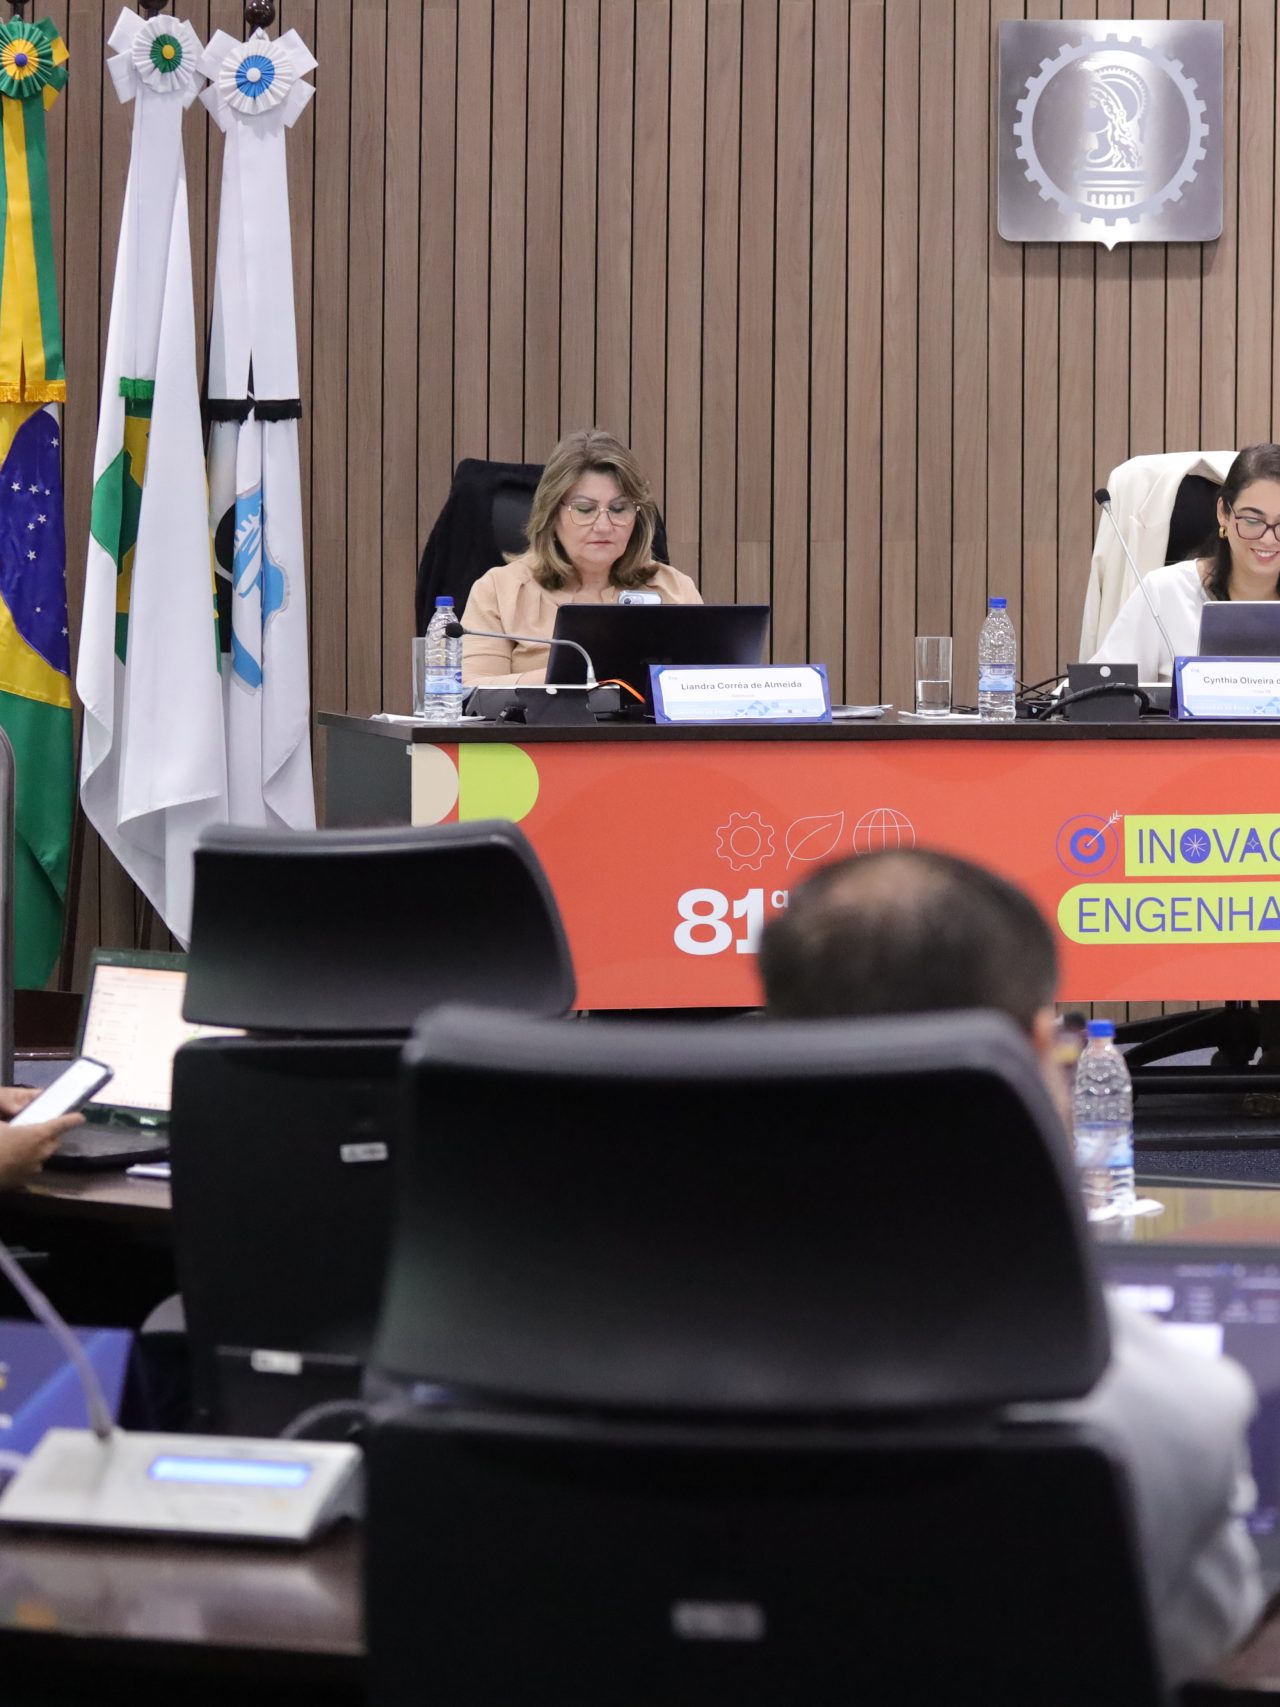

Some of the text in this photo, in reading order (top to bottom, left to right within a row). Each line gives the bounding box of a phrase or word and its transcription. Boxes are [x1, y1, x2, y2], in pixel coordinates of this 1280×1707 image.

[681, 683, 715, 691] Liandra
[751, 681, 762, 689] de
[764, 680, 802, 689] Almeida
[1203, 676, 1238, 685] Cynthia
[1240, 676, 1274, 685] Oliveira
